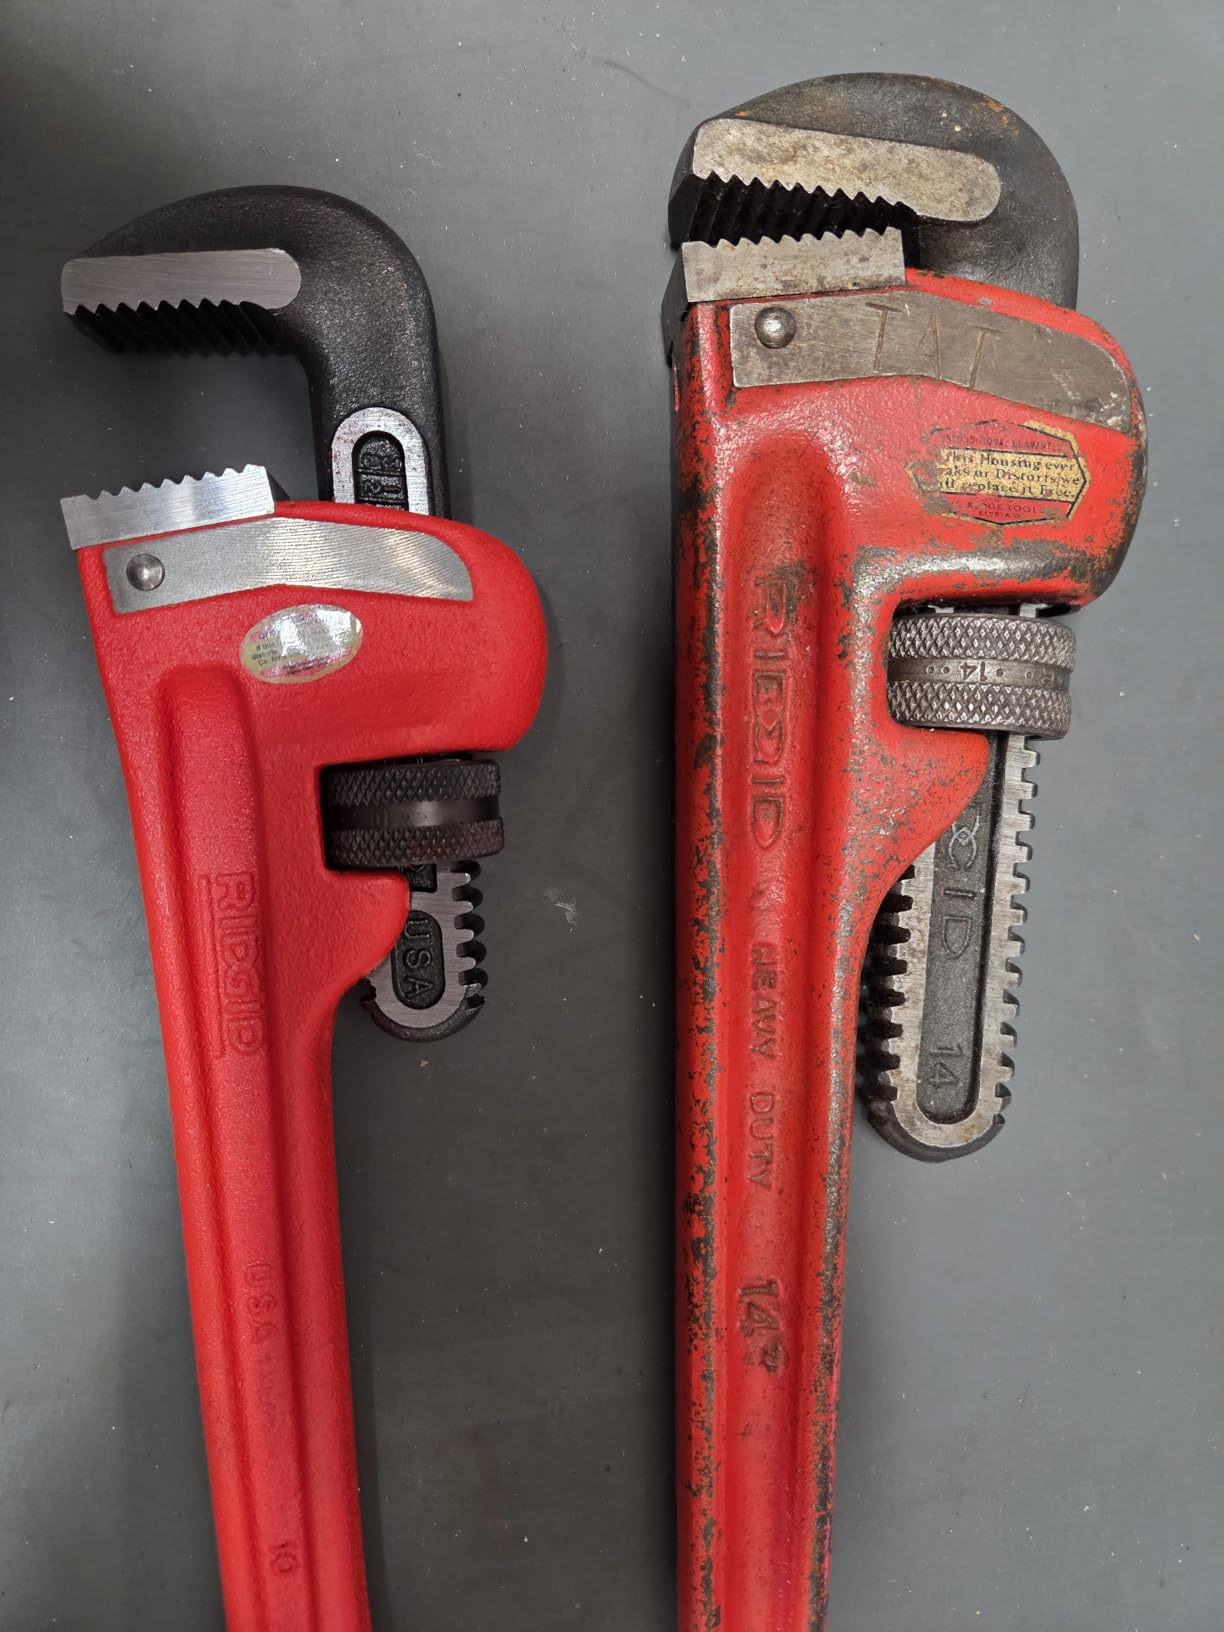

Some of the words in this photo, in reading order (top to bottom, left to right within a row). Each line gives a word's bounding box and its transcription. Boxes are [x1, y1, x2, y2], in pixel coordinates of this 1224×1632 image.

[980, 453, 1041, 471] Housing
[1045, 461, 1075, 472] ever
[1060, 476, 1080, 485] we
[1008, 503, 1038, 513] TOOL
[959, 660, 988, 682] 14
[216, 871, 265, 1057] RIDGID
[403, 918, 435, 999] USA
[749, 941, 779, 1060] HEAVY
[927, 1041, 967, 1092] 14
[749, 1091, 776, 1192] DUTY
